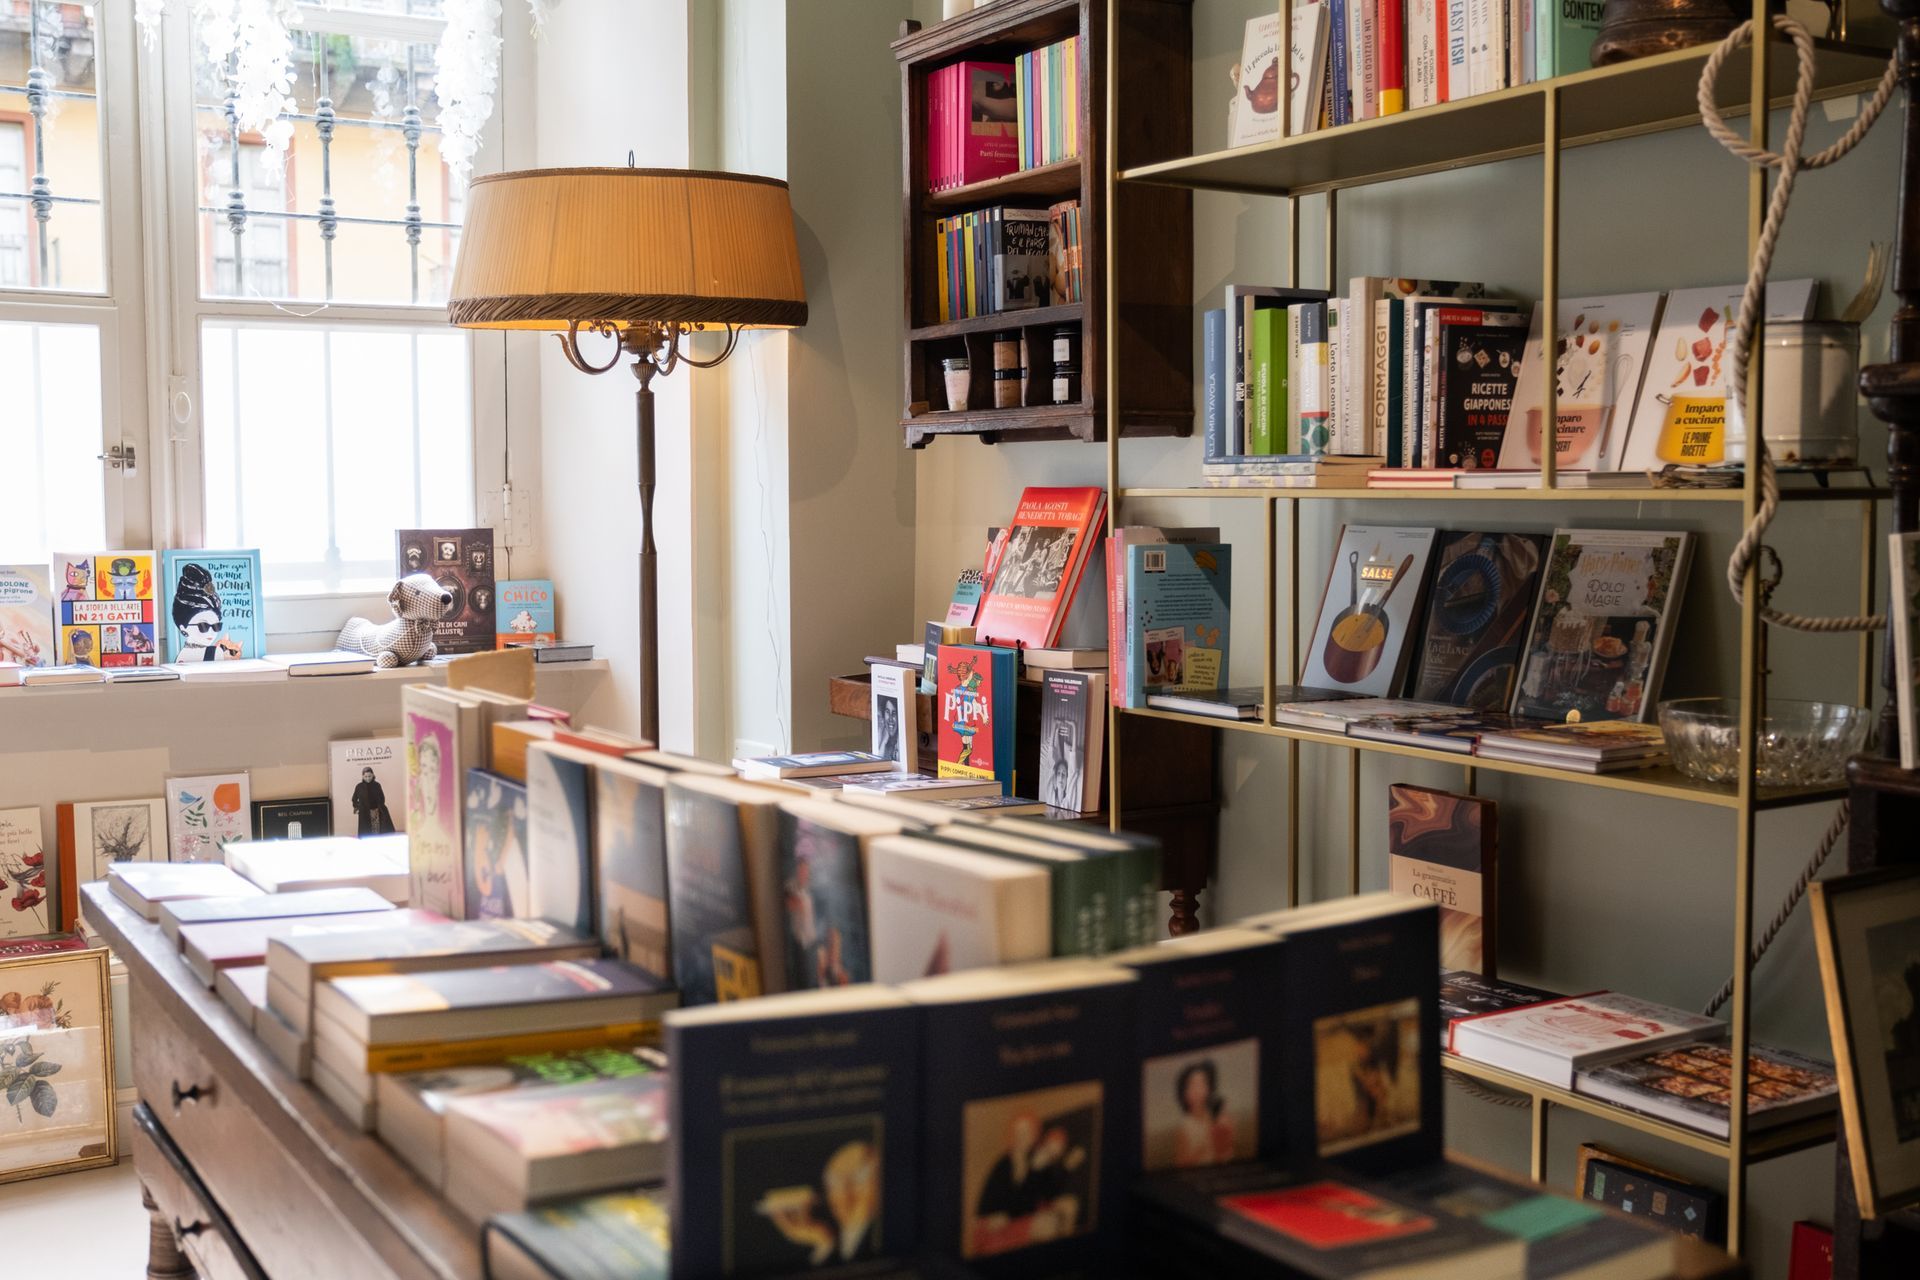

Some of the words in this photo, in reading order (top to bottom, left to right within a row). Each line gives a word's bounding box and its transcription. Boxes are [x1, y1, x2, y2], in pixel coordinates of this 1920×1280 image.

[1451, 1, 1464, 32] EASY
[1364, 18, 1371, 32] UN
[1364, 34, 1372, 70] PIZZICO
[1451, 36, 1464, 66] FISH
[1365, 73, 1372, 83] DI
[1004, 221, 1034, 236] TRUMAN
[1330, 342, 1338, 372] L'orto
[1330, 375, 1338, 385] in
[1376, 325, 1387, 429] FORMAGGI
[1235, 382, 1244, 401] POLPO
[1471, 382, 1508, 395] RICETTE
[1261, 396, 1267, 405] DI
[1685, 404, 1725, 414] Imparo
[1557, 425, 1586, 433] cinare
[1682, 432, 1691, 444] LE
[1692, 431, 1713, 444] PRIME
[1680, 444, 1708, 457] RICETTE
[1021, 502, 1042, 510] PAOLA
[1044, 502, 1069, 511] AGOSTI
[1361, 567, 1393, 579] SALSE
[216, 580, 250, 591] DONNA
[1587, 579, 1625, 593] DOLCI
[503, 591, 548, 603] CHICO
[1584, 593, 1622, 607] MAGIE
[74, 602, 83, 611] LA
[86, 602, 108, 611] STORIA
[222, 608, 253, 618] GATTO
[75, 613, 87, 621] IN
[91, 613, 104, 621] 21
[107, 612, 140, 621] GATTI
[944, 690, 989, 723] Pippi
[345, 746, 392, 758] PRADA
[1413, 868, 1420, 877] La
[1413, 882, 1457, 907] CAFFÈ
